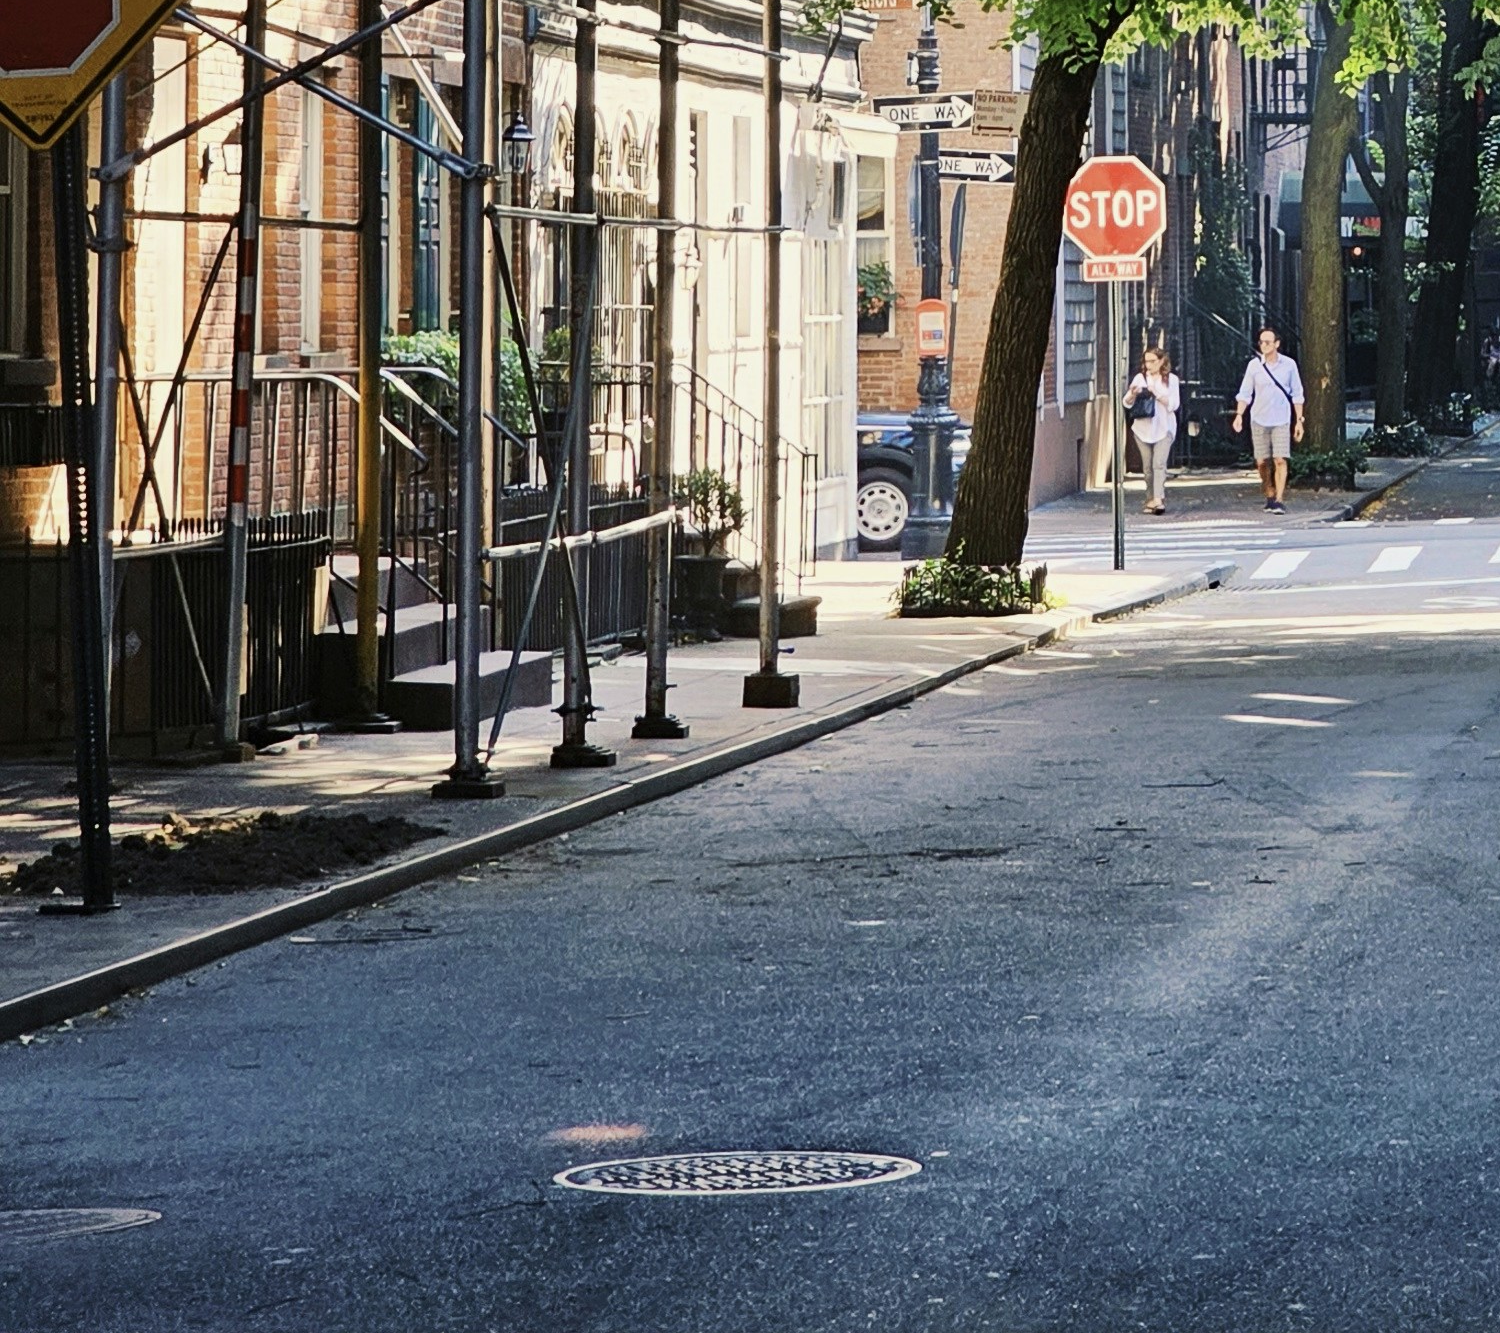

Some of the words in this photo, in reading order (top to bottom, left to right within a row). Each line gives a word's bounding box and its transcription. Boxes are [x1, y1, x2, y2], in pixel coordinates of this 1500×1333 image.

[978, 94, 987, 103] NO
[989, 94, 1018, 104] PARKING
[889, 107, 919, 121] ONE
[934, 105, 966, 119] WAY
[975, 161, 1003, 174] WAY
[1070, 190, 1157, 229] STOP
[1092, 264, 1113, 276] ALL
[1117, 263, 1138, 275] WAY
